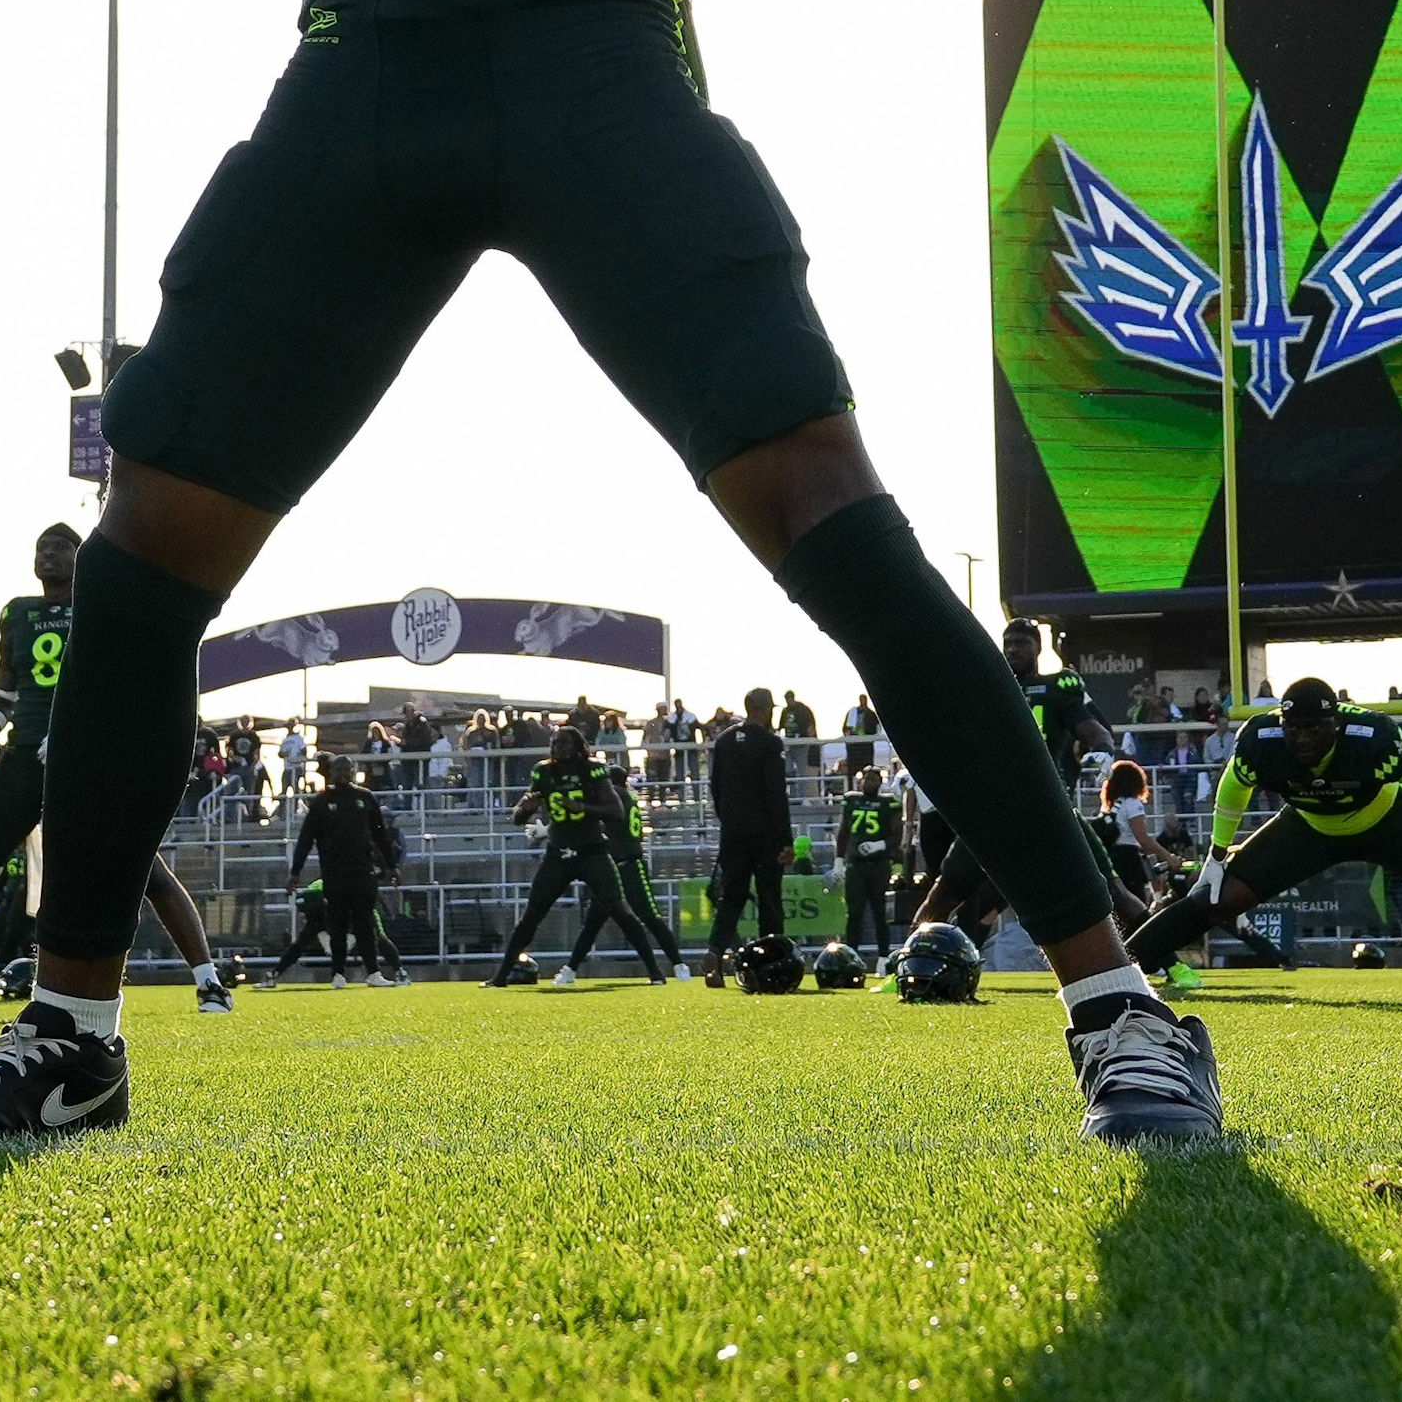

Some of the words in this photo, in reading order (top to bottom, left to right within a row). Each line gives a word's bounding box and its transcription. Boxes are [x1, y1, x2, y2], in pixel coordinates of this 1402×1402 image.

[402, 597, 451, 641] Rabbit
[415, 623, 447, 661] Hole
[1079, 653, 1136, 674] Modelo
[851, 810, 880, 834] 75
